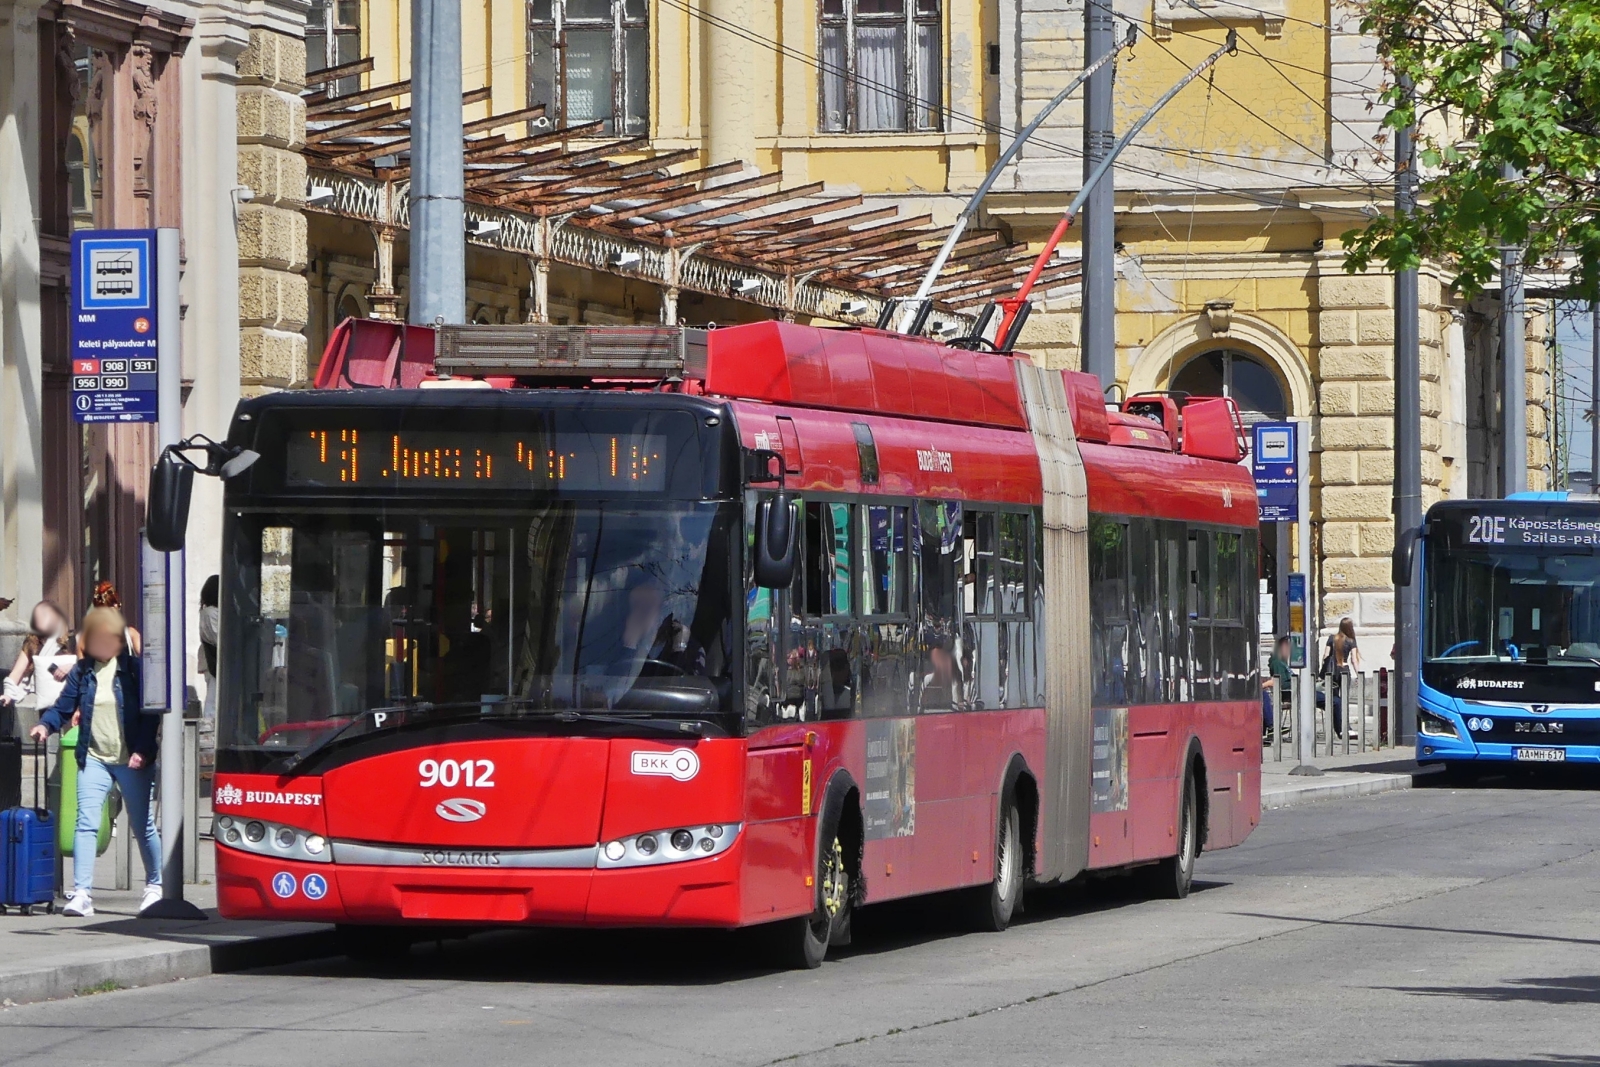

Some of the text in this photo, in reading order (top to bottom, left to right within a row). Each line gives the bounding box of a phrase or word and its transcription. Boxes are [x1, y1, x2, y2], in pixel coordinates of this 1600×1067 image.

[79, 314, 96, 322] MM
[136, 322, 147, 330] F2
[79, 340, 100, 348] Keleti
[103, 340, 145, 349] pályaudvar
[80, 361, 152, 371] 76 908 931
[78, 378, 124, 388] 956 990
[1469, 515, 1600, 544] 20E Káposztásmeg
[1523, 531, 1600, 545] Szilas-pat
[1477, 680, 1525, 689] BUDAPEST
[374, 712, 387, 728] P
[1515, 722, 1564, 734] MAN
[640, 757, 669, 769] BKK
[418, 758, 495, 788] 9012
[245, 790, 322, 806] BUDAPEST
[421, 850, 501, 866] SOLARIS
